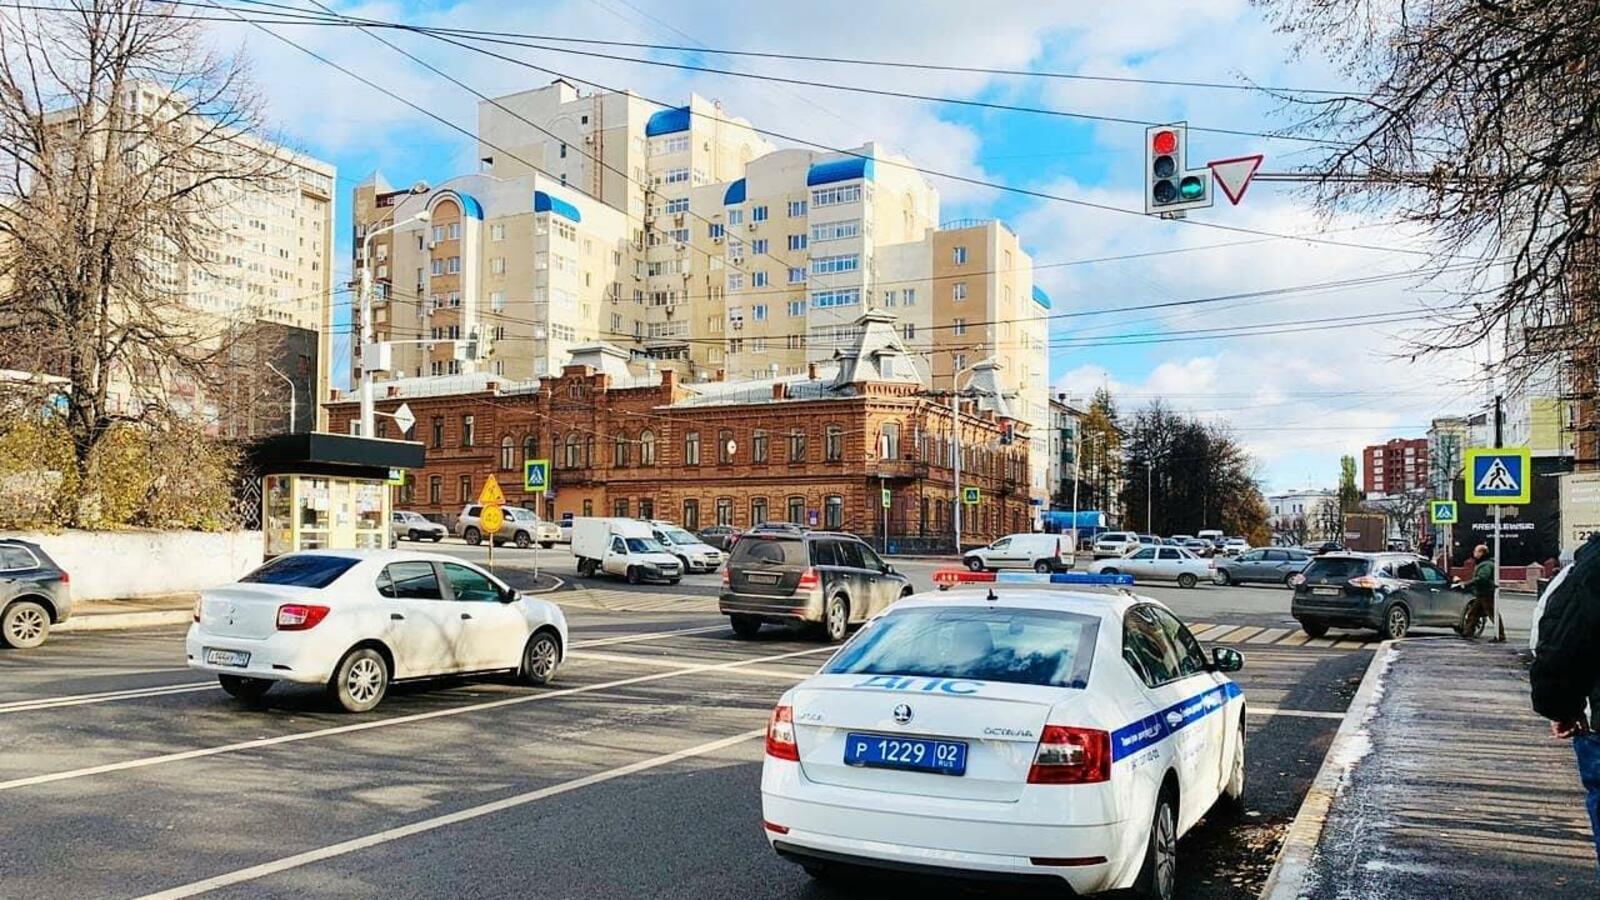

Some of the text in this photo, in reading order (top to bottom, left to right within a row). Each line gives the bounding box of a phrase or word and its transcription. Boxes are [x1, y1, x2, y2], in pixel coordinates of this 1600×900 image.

[854, 675, 986, 695] ДПС
[878, 740, 926, 763] 1229
[937, 744, 958, 761] 02
[938, 760, 954, 768] RUS
